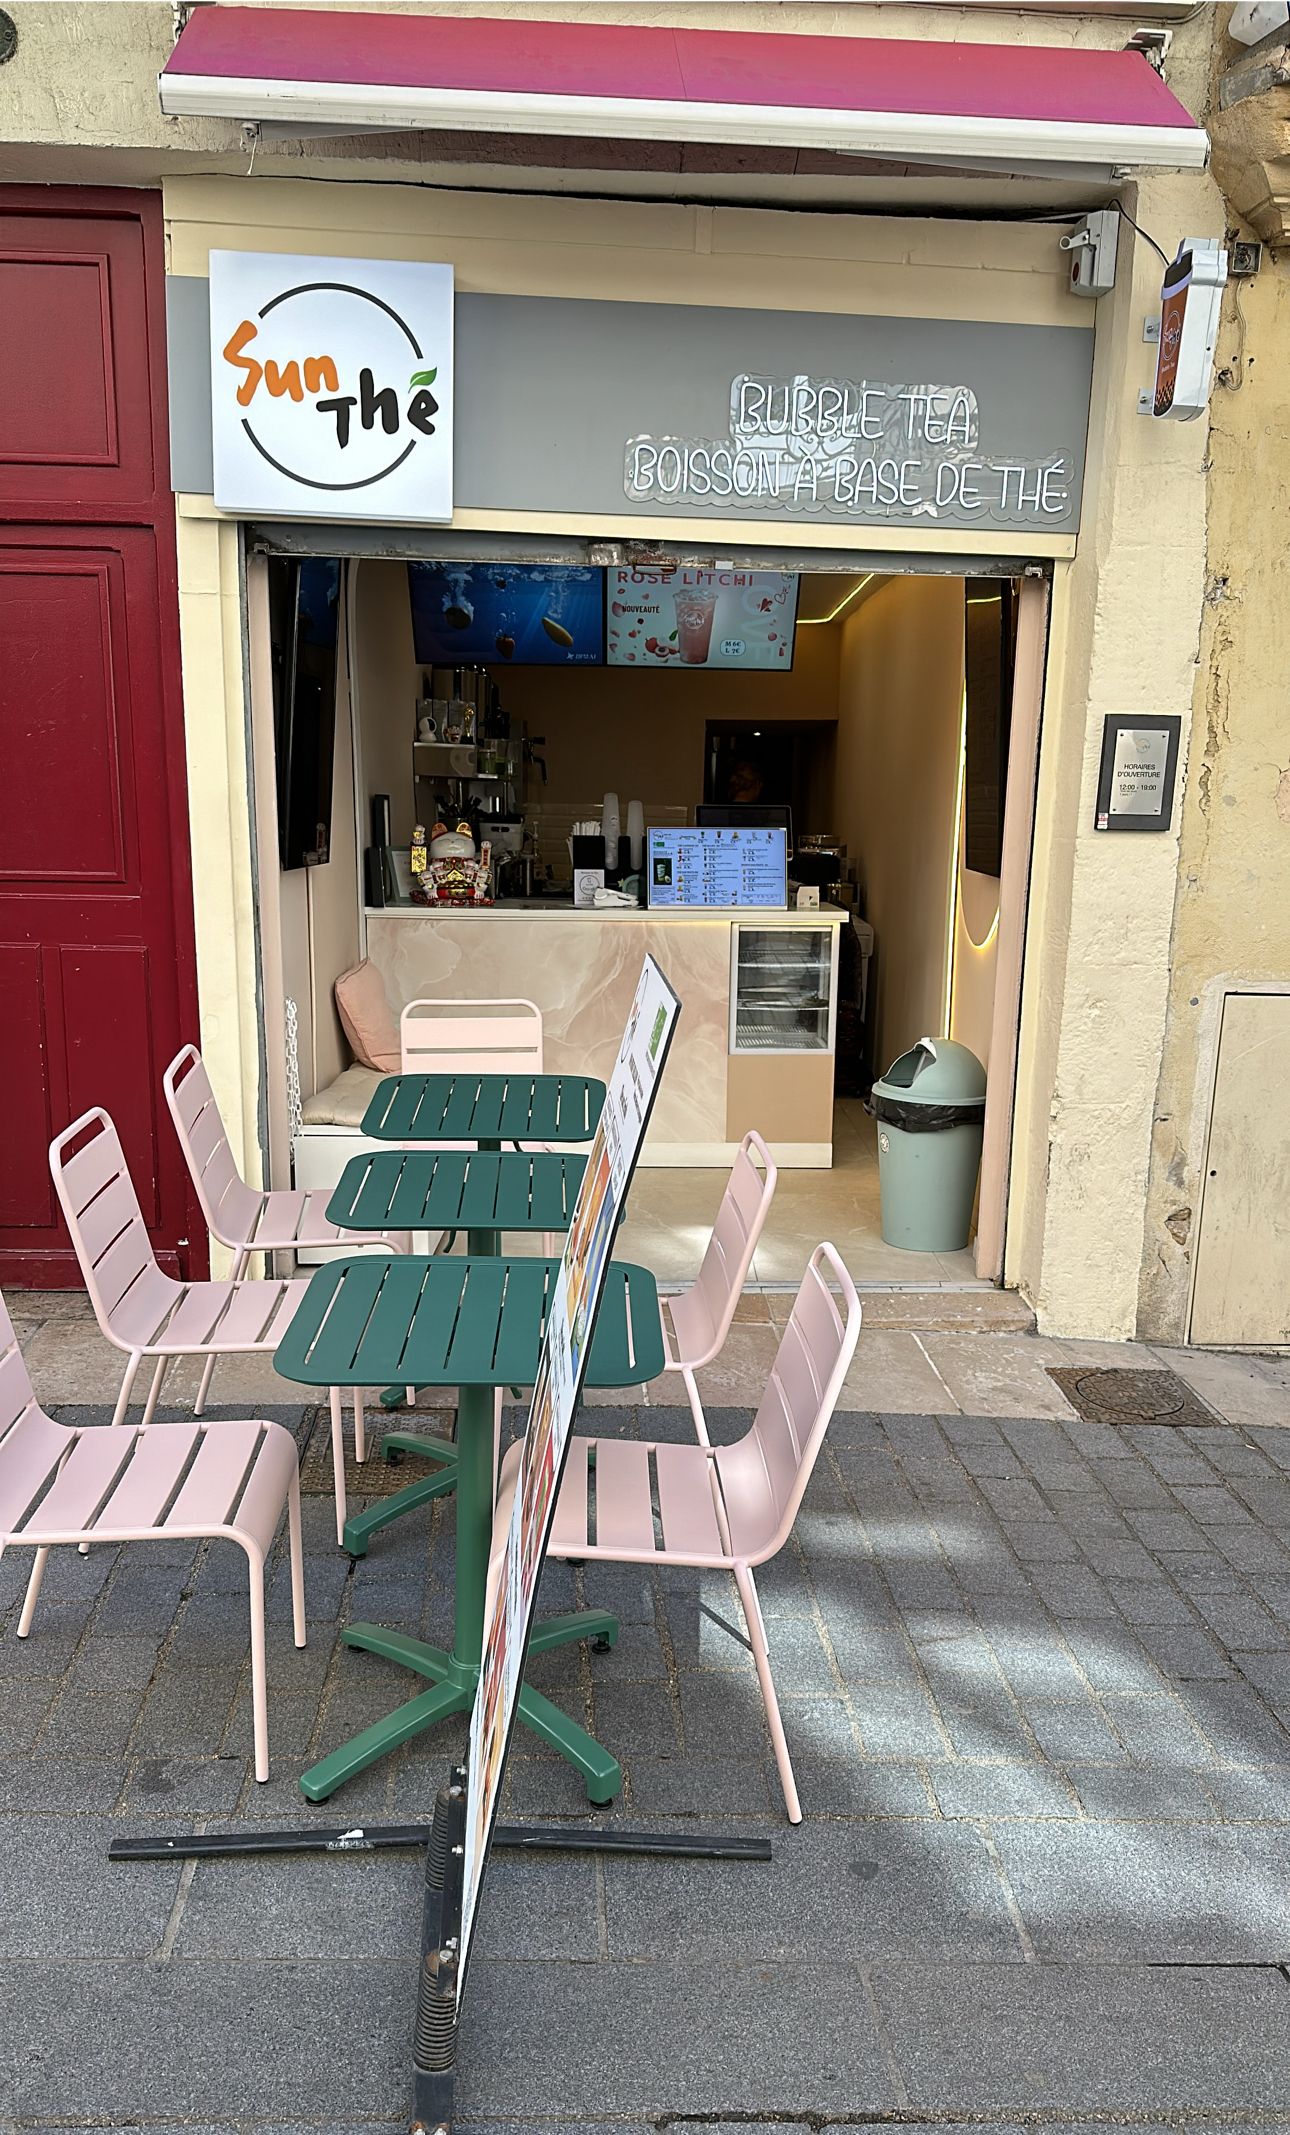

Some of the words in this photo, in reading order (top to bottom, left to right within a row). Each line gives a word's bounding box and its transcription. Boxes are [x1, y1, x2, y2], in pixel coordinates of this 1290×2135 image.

[223, 320, 339, 407] Sun
[738, 381, 884, 440] BUBBLE
[898, 393, 970, 445] TEA
[631, 445, 781, 498] BOISSON
[794, 446, 818, 502] À
[834, 458, 923, 506] BASE
[935, 463, 983, 510] DE
[992, 460, 1066, 513] THÉ
[617, 571, 671, 584] ROSE
[683, 570, 753, 587] LITCHI
